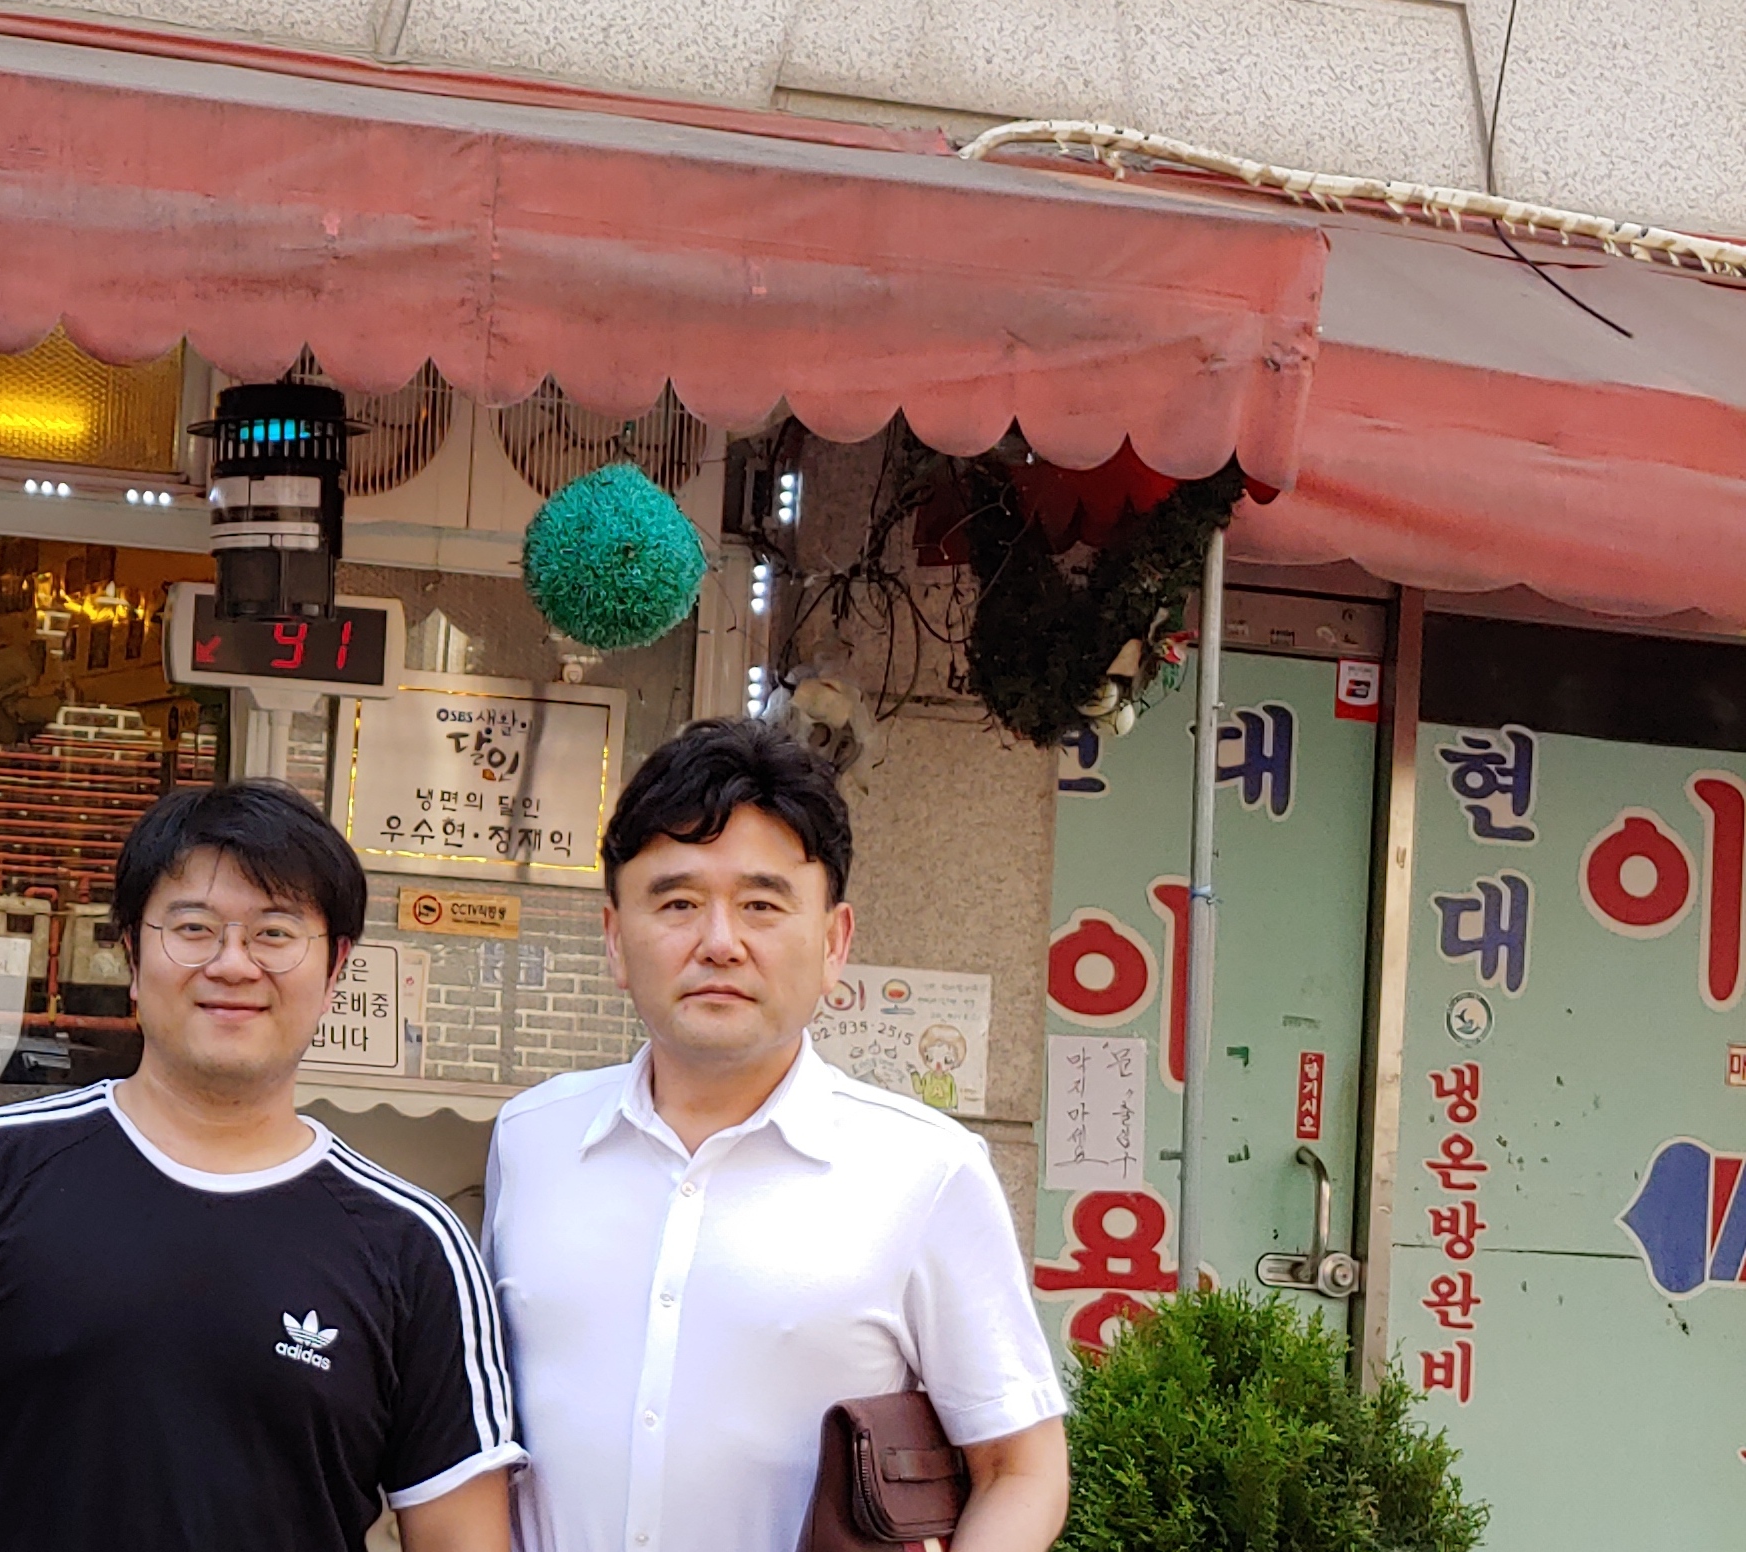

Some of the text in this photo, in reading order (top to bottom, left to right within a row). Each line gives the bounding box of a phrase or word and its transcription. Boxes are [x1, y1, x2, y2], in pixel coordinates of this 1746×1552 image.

[416, 787, 541, 819] 냉면의 달인
[1436, 725, 1537, 995] 현대
[331, 989, 390, 1020] 준비중
[1422, 1064, 1486, 1404] 냉온방완비
[275, 1341, 332, 1371] adidas
